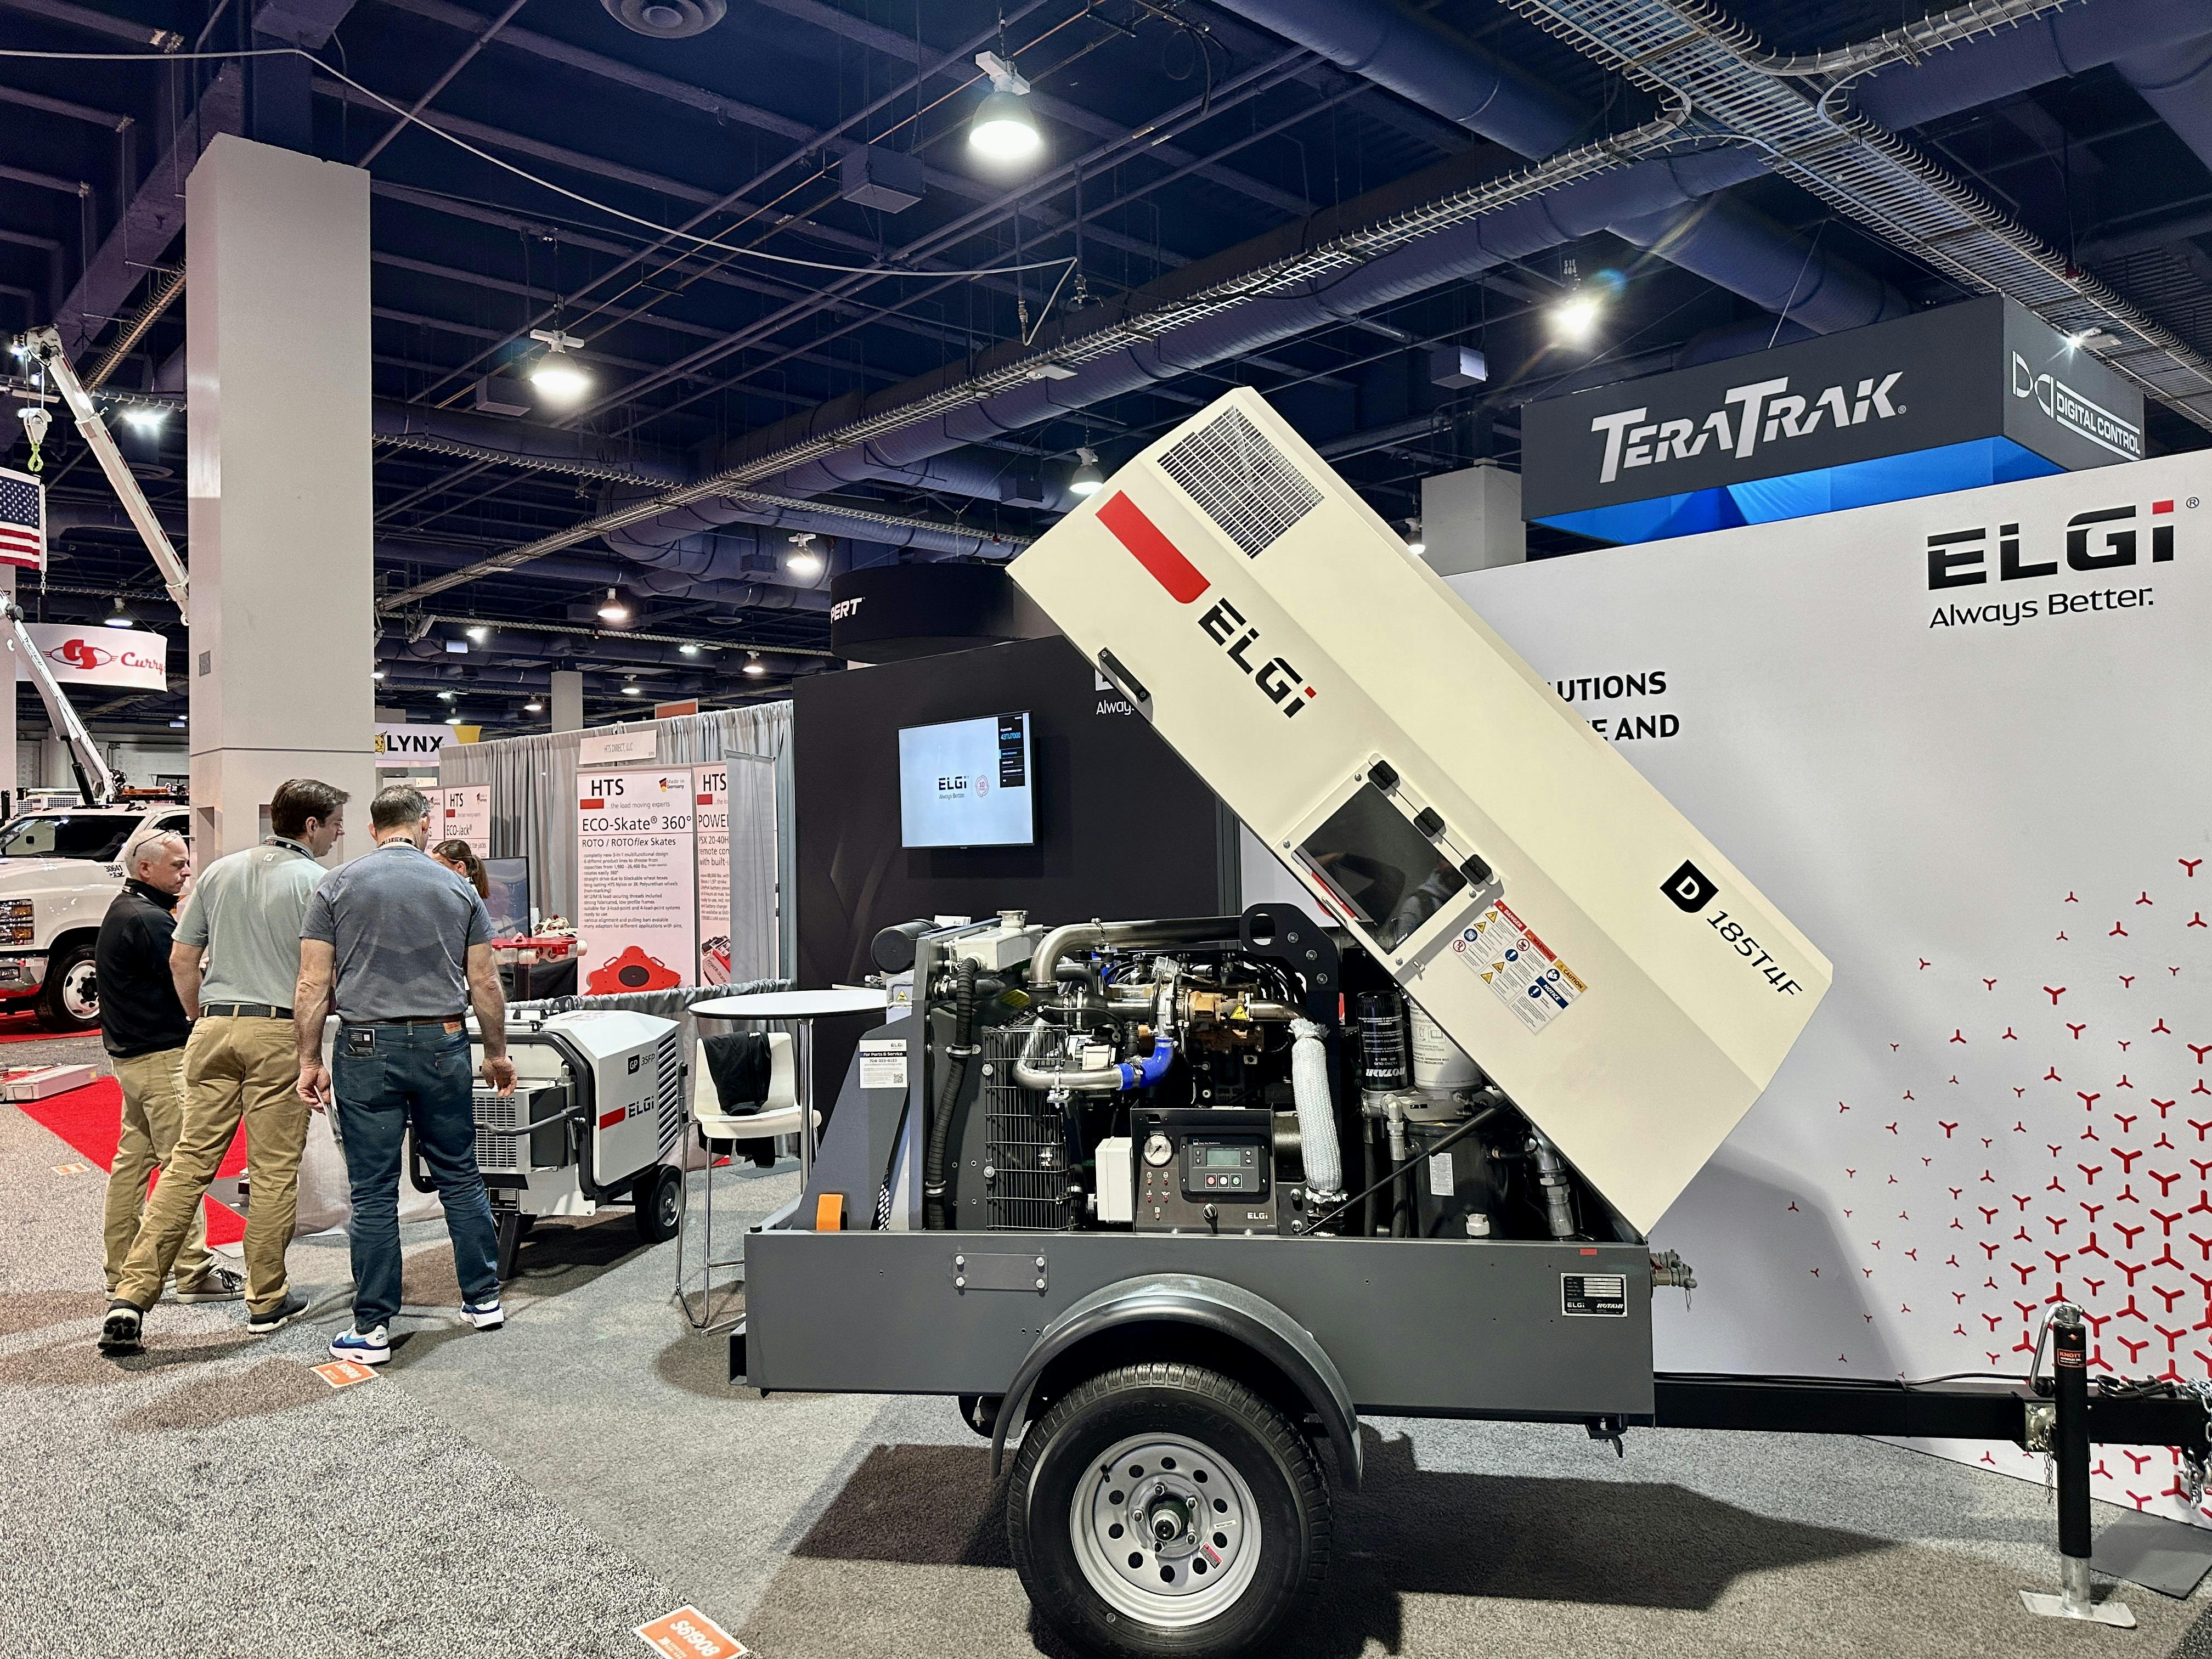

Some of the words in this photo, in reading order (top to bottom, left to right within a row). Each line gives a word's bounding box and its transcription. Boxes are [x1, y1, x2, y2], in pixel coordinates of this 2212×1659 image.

[2057, 392, 2096, 432] DIGITAL
[2097, 417, 2140, 454] CONTROL
[1929, 600, 2038, 628] Always
[2048, 588, 2153, 616] Better.
[1547, 671, 1667, 703] UTIONS
[1096, 699, 1135, 715] Alway
[1615, 714, 1679, 741] AND
[387, 735, 443, 752] LYNX
[591, 778, 624, 796] HTS
[703, 773, 727, 792] HTS
[450, 793, 464, 807] HTS
[662, 816, 691, 830] 360°
[698, 814, 729, 828] POWE
[582, 839, 604, 848] ROTO
[606, 839, 610, 847] /
[612, 838, 648, 847] ROTOflex
[651, 837, 676, 846] Skates
[1675, 876, 1700, 900] D
[1503, 909, 1523, 929] DANGER
[1532, 937, 1554, 960] WARNING
[1706, 910, 1803, 996] 185T4F
[1563, 969, 1583, 989] CAUTION
[1543, 984, 1561, 1002] NOTICE
[630, 1059, 638, 1070] GP
[641, 1053, 655, 1066] 35FP
[629, 1096, 654, 1119] ELGi
[670, 1620, 720, 1657] S61908
